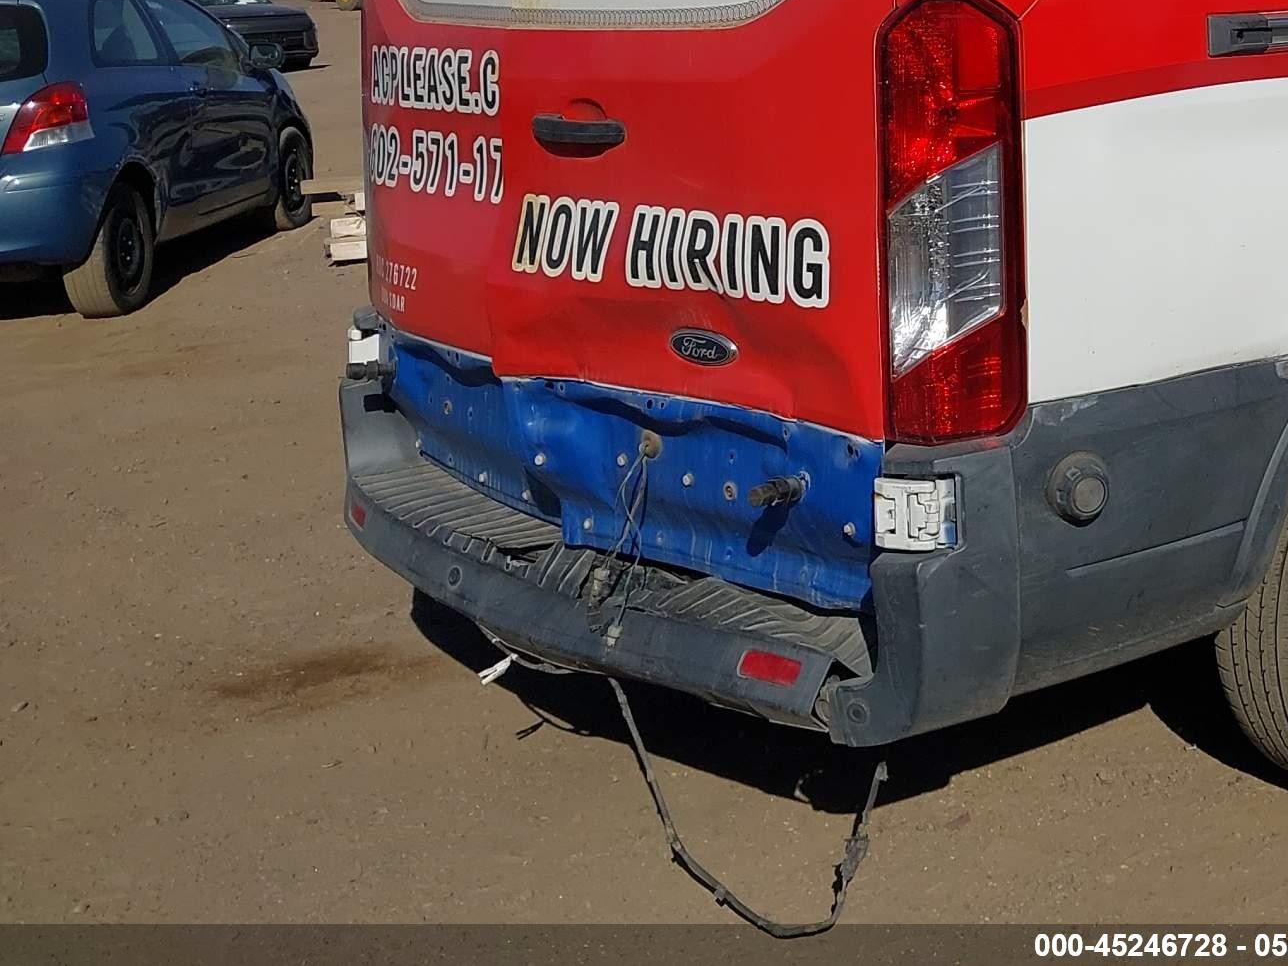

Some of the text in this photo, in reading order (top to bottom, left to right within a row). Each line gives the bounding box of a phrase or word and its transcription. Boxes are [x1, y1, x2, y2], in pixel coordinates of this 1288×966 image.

[512, 195, 830, 308] NOW HIRING
[681, 337, 718, 359] Ford
